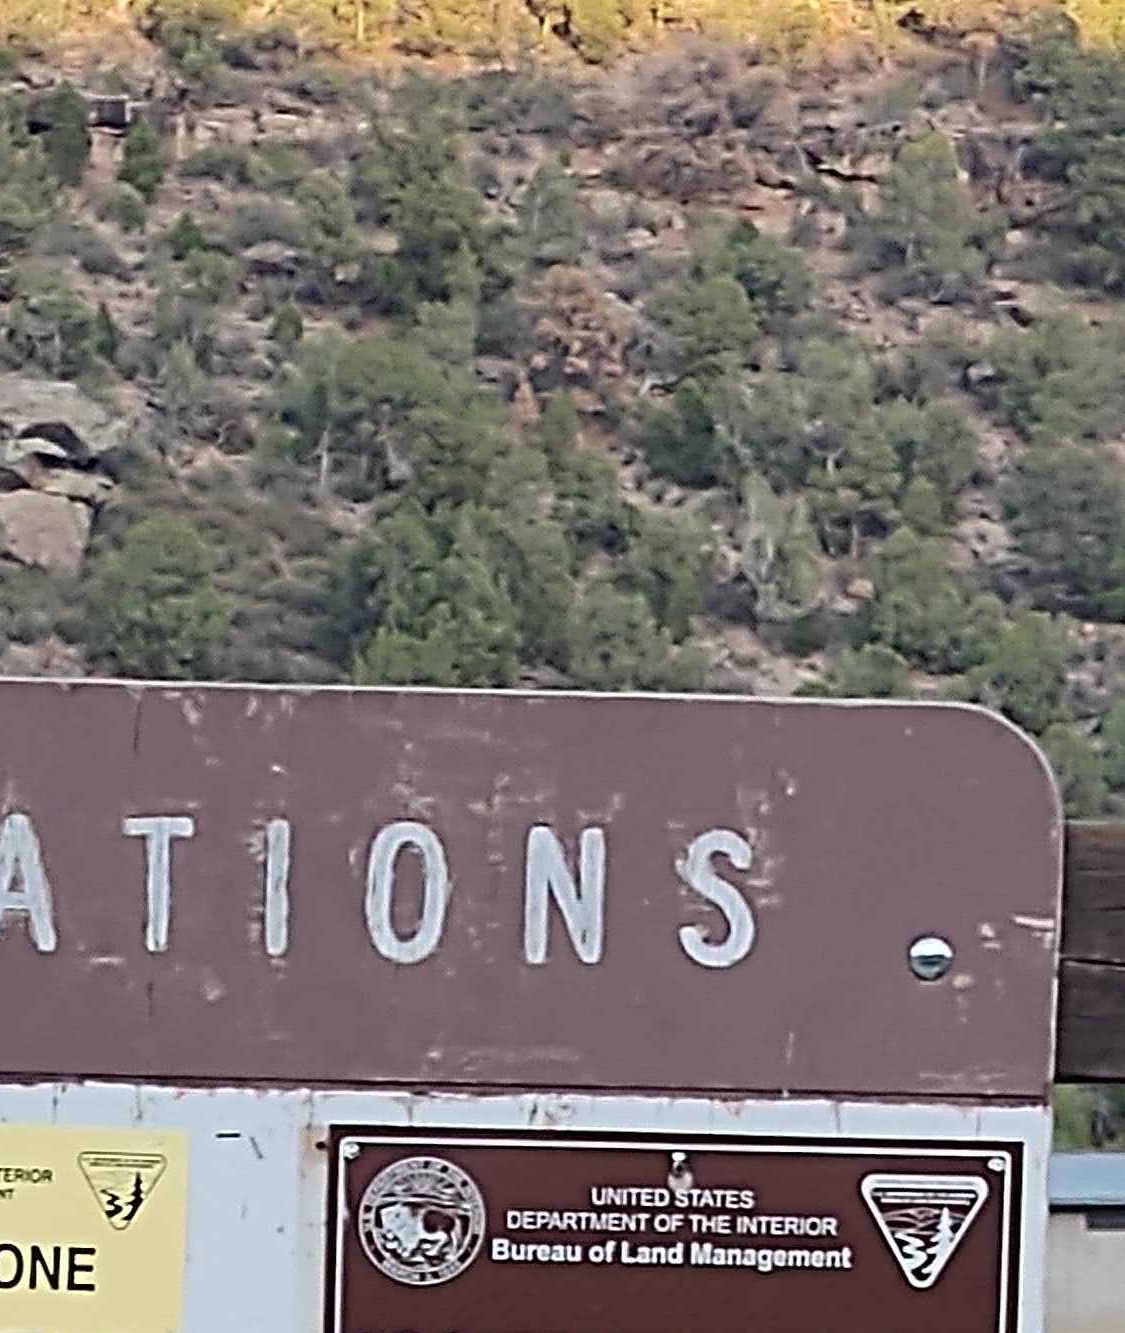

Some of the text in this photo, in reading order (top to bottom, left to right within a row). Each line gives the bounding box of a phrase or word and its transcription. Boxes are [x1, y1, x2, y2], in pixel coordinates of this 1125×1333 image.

[591, 1187, 754, 1210] UNITED STATES
[506, 1211, 837, 1238] DEPARTMENT OF THE INTERIOR
[490, 1240, 852, 1271] Bureau of Land Management
